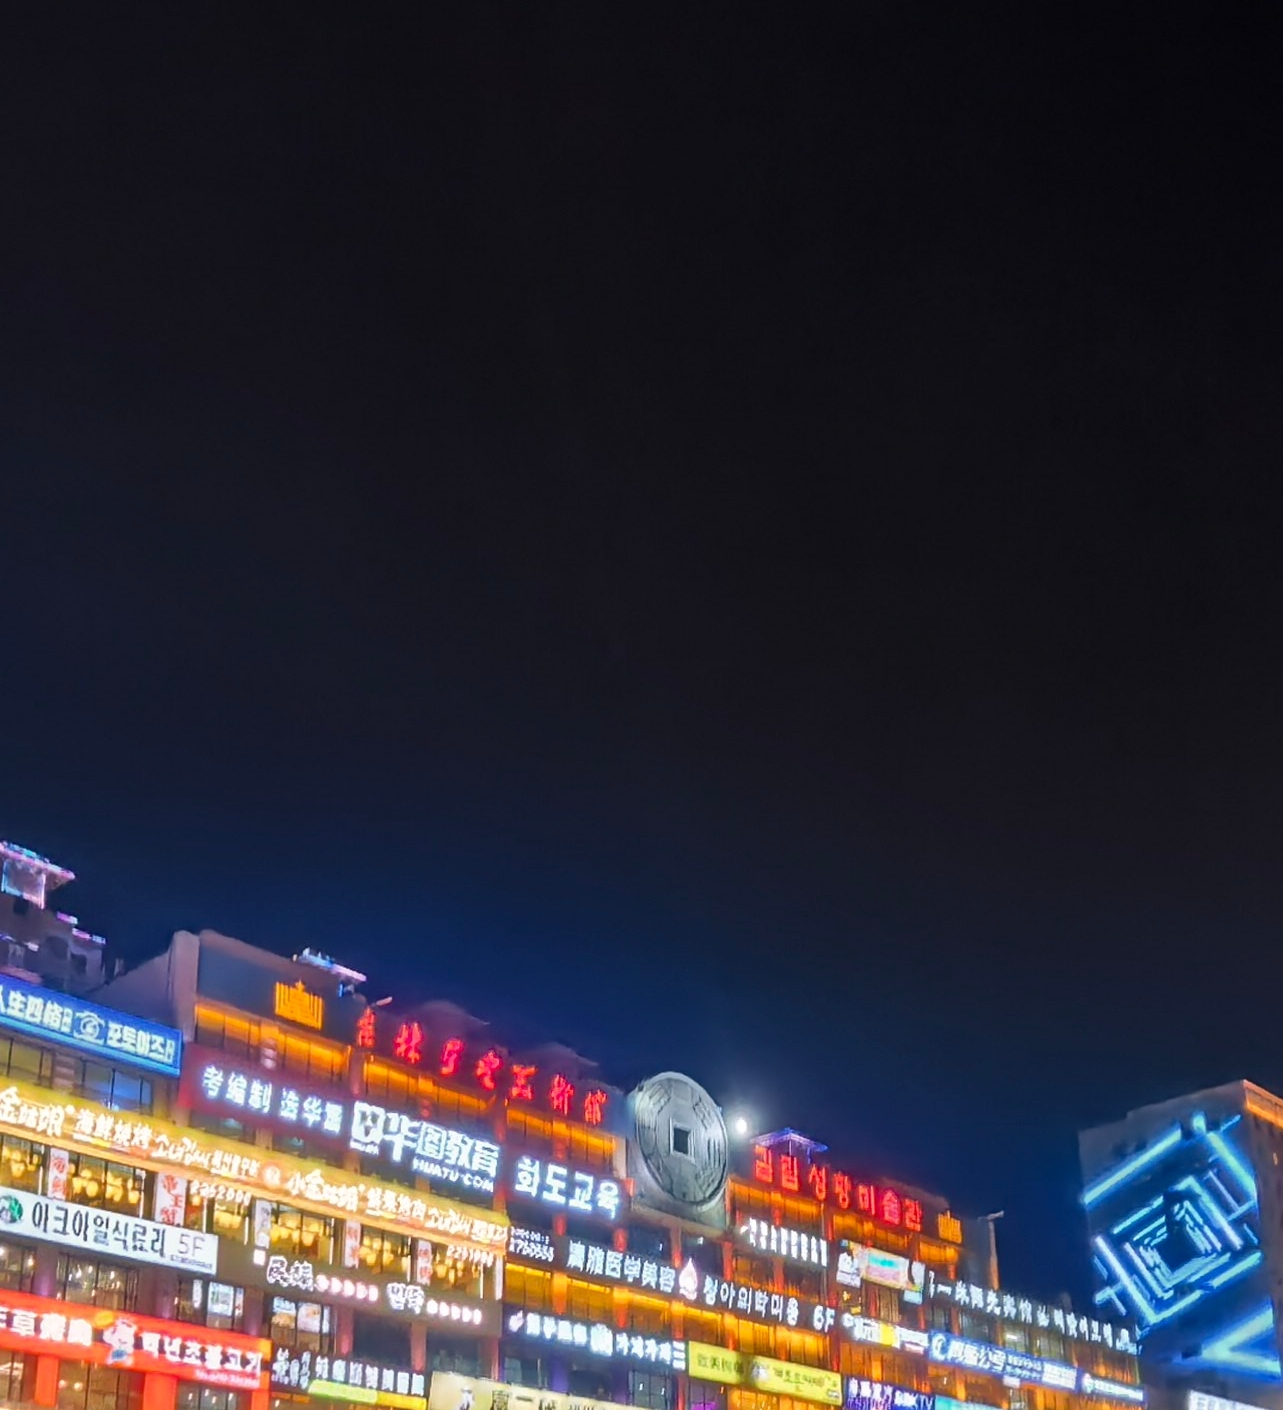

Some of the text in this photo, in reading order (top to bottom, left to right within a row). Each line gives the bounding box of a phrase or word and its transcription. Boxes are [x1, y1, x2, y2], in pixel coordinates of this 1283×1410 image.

[379, 1112, 501, 1178] 华图教育
[178, 1233, 206, 1257] 5F
